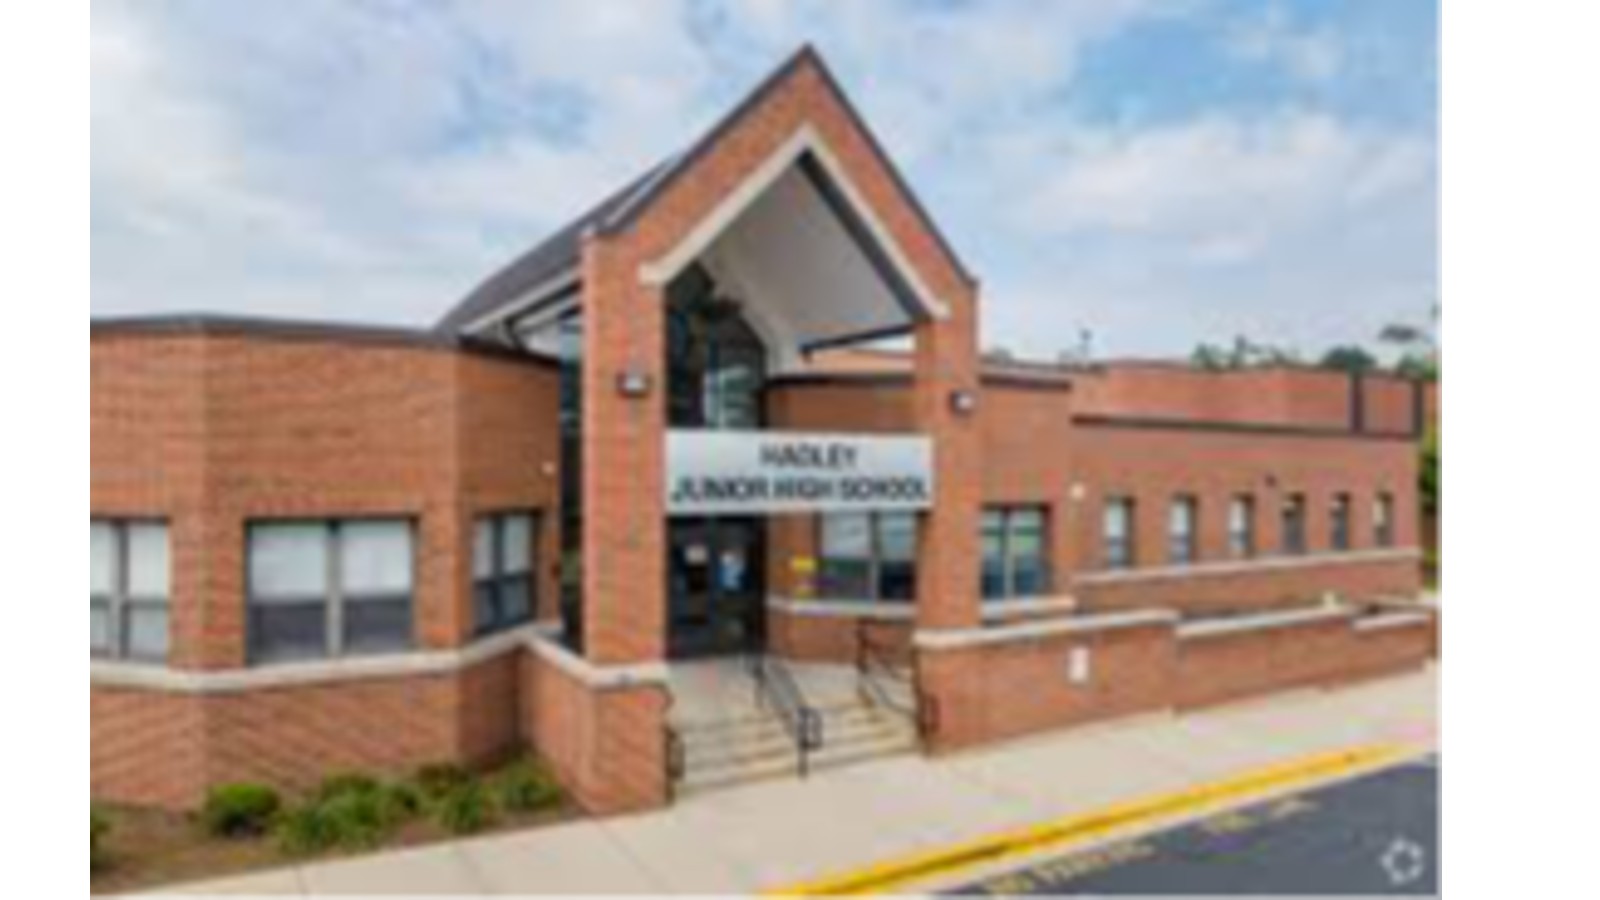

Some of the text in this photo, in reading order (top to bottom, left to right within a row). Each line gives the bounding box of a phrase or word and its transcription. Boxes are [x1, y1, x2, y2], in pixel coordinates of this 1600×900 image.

[759, 443, 858, 469] HADLEY
[671, 476, 928, 502] JUNIOR HIGH SCHOOL
